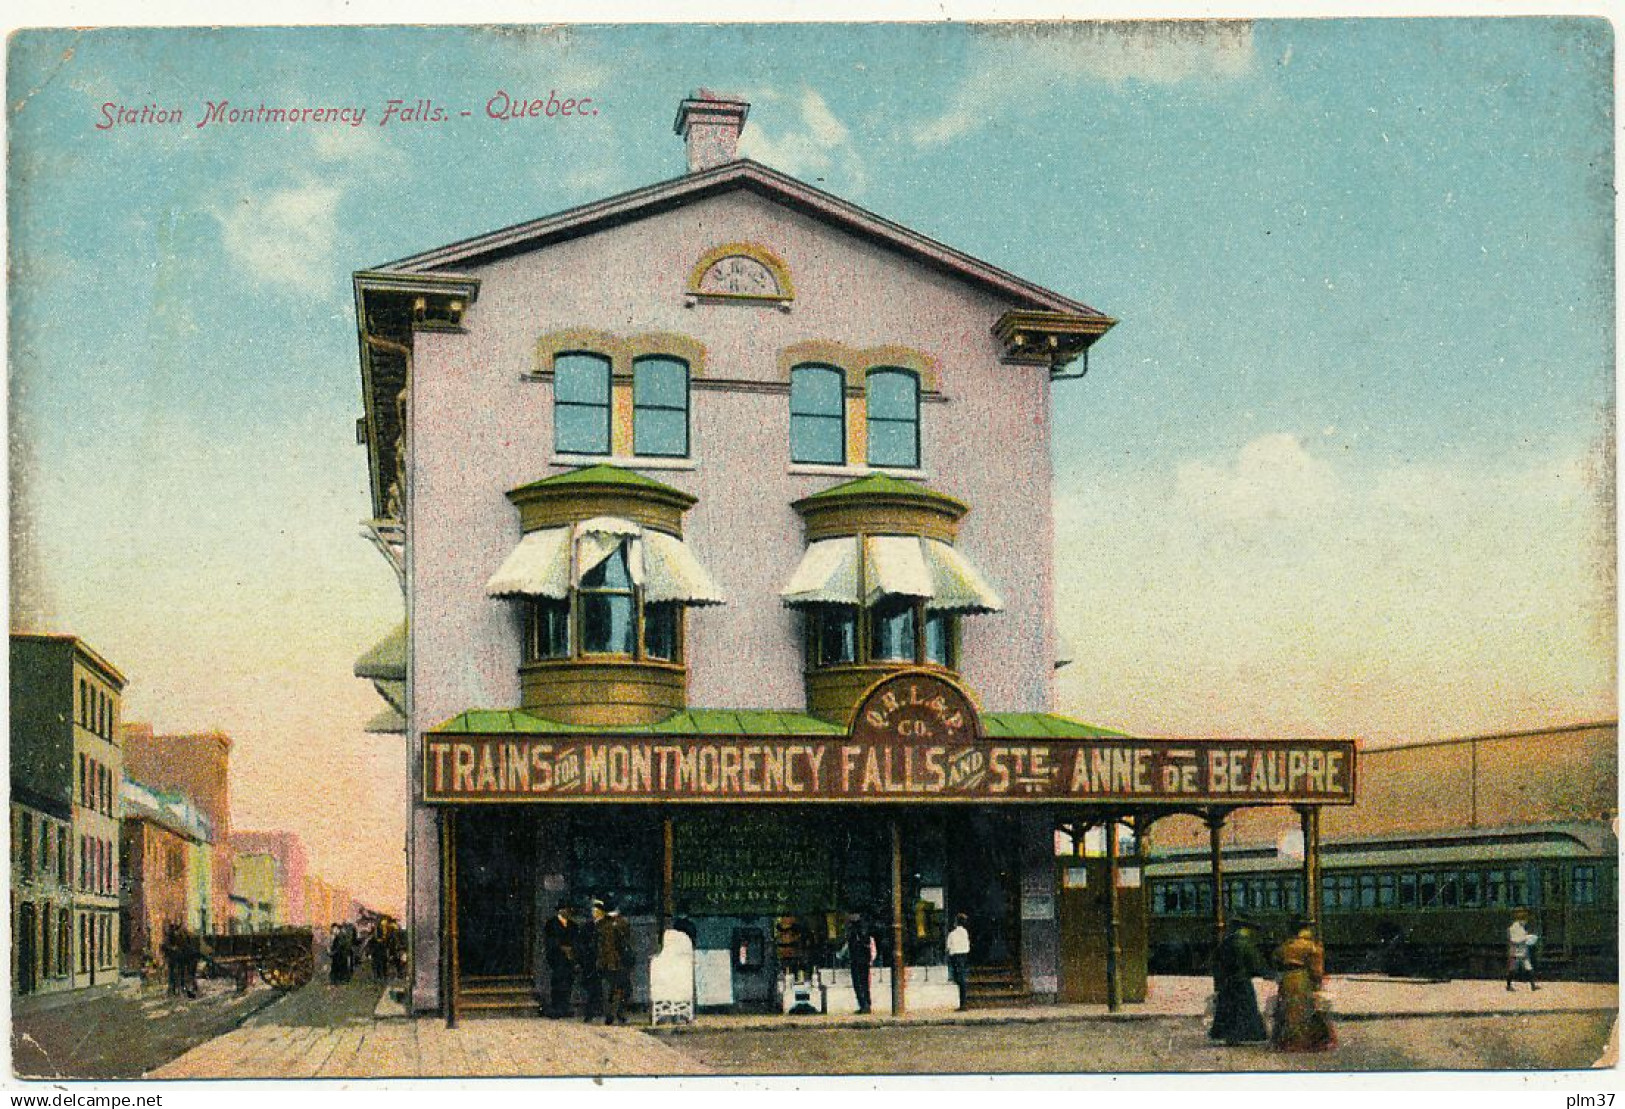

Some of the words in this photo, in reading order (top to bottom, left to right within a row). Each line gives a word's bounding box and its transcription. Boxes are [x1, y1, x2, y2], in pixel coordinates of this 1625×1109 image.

[429, 742, 553, 793] TRAINS
[554, 754, 580, 786] FOR
[585, 743, 826, 794] MONTMORENCY
[841, 744, 946, 794] FALLS
[948, 750, 984, 788] AND
[1071, 747, 1153, 794] ANNE
[1162, 765, 1198, 793] DE
[1208, 749, 1344, 795] BEAUPRE
